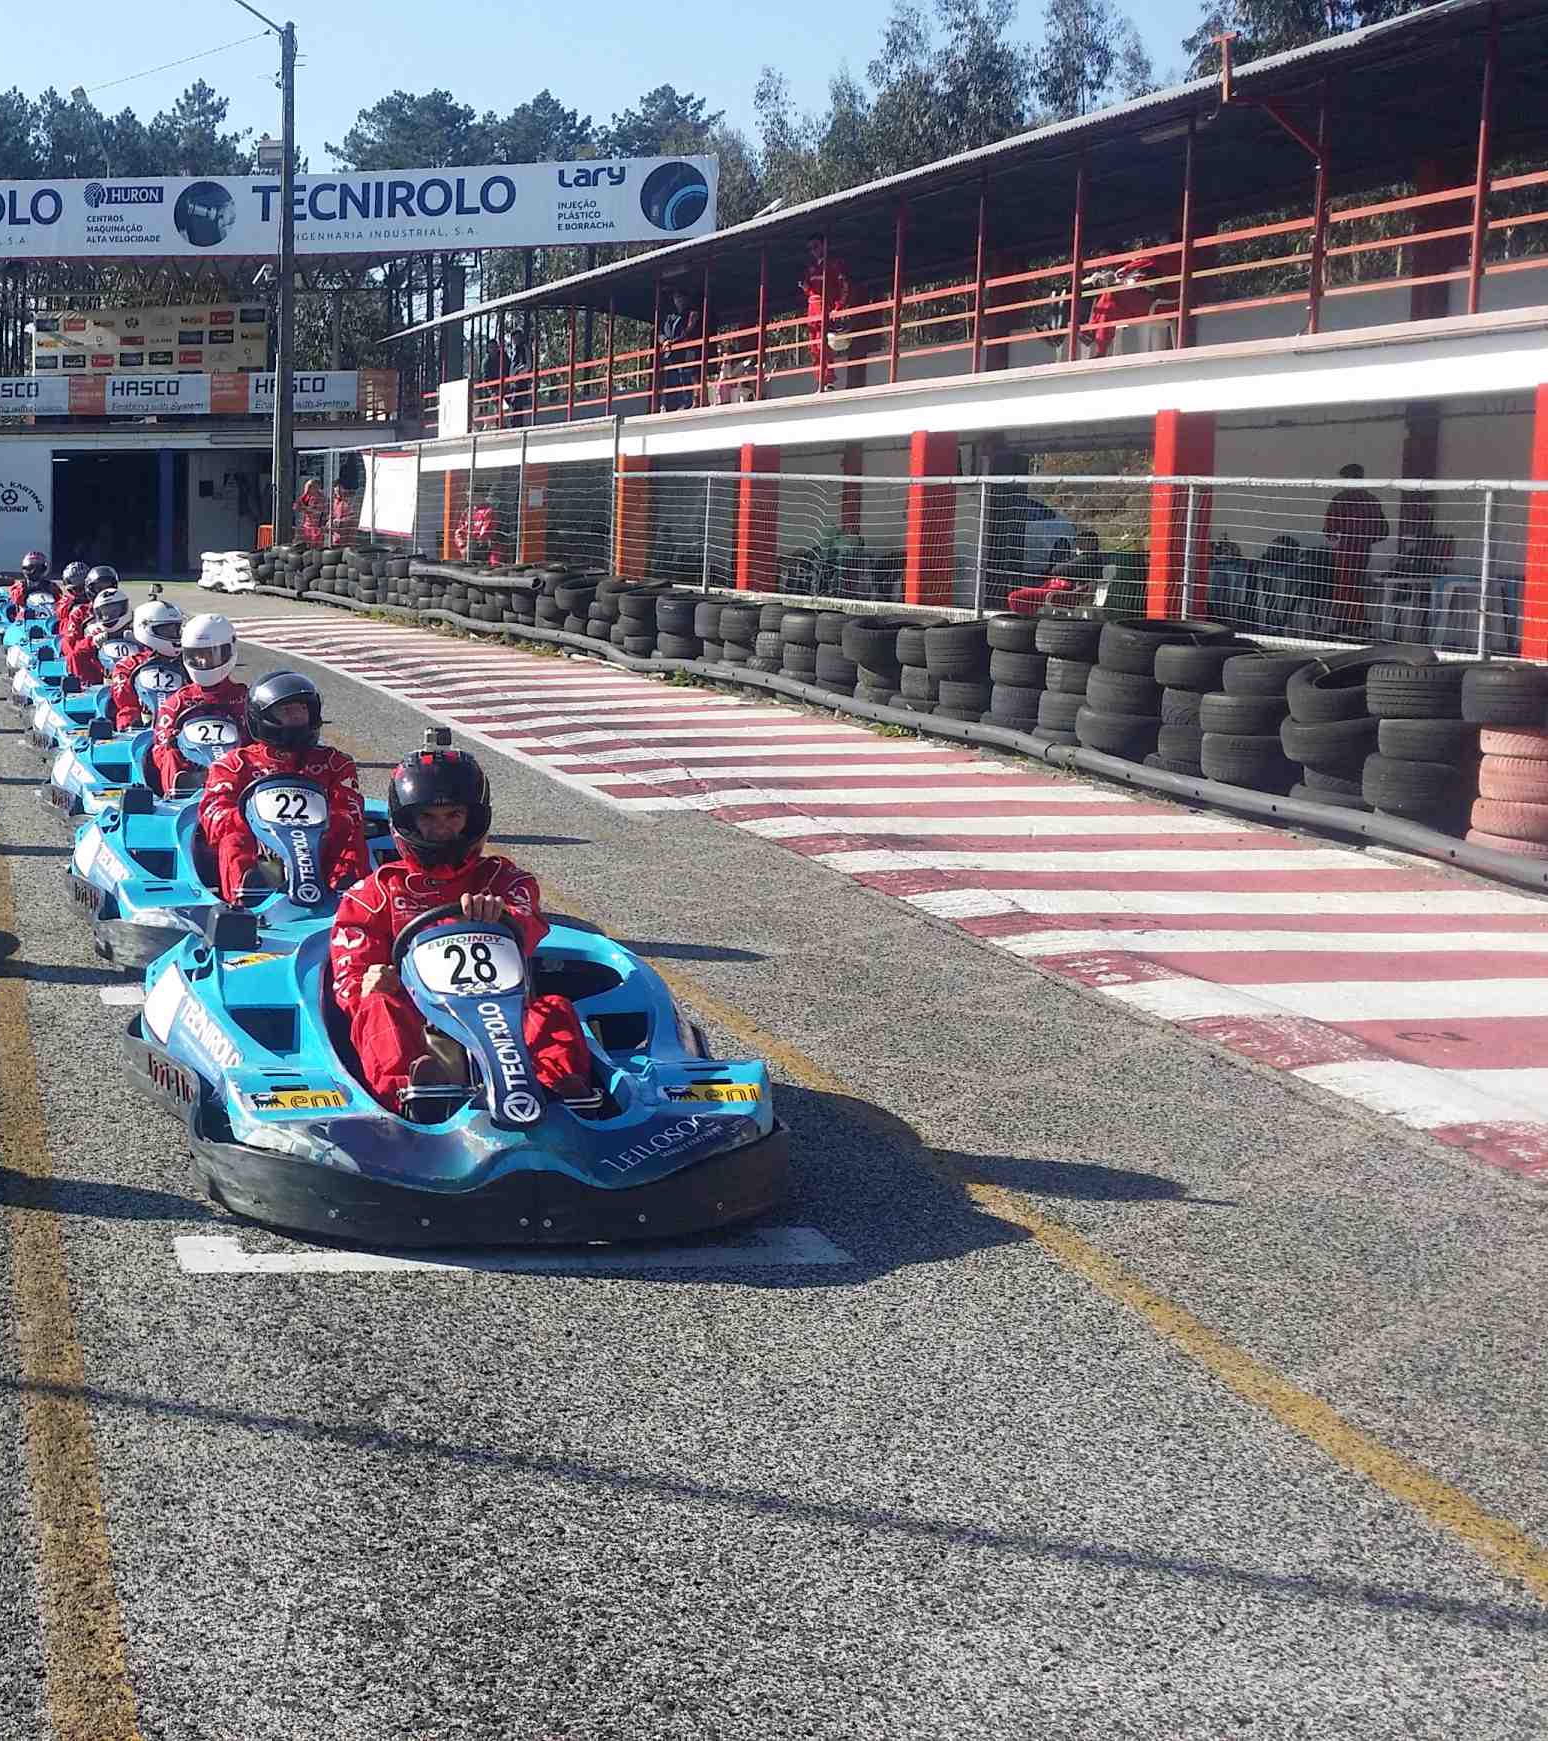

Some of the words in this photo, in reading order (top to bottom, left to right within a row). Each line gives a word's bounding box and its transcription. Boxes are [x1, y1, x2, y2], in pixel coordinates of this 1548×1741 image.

[111, 187, 160, 202] HURON
[557, 199, 597, 210] INJEÇÃO
[87, 215, 124, 223] CENTROS
[557, 210, 601, 220] PLÁSTICO
[87, 224, 143, 234] MAQUINAÇÃO
[565, 221, 615, 231] BORRACHA
[86, 235, 108, 243] ALTA
[109, 234, 160, 243] VELOCIDADE
[112, 379, 180, 397] HASCO
[10, 481, 44, 512] KARTING
[115, 645, 129, 656] 10
[153, 672, 174, 687] 12
[198, 725, 224, 741] 27
[275, 793, 309, 819] 22
[428, 934, 501, 950] EUROINDY
[444, 942, 497, 985] 28
[477, 1001, 528, 1091] TECNIROLO
[290, 1092, 343, 1109] eni
[705, 1087, 758, 1101] eni
